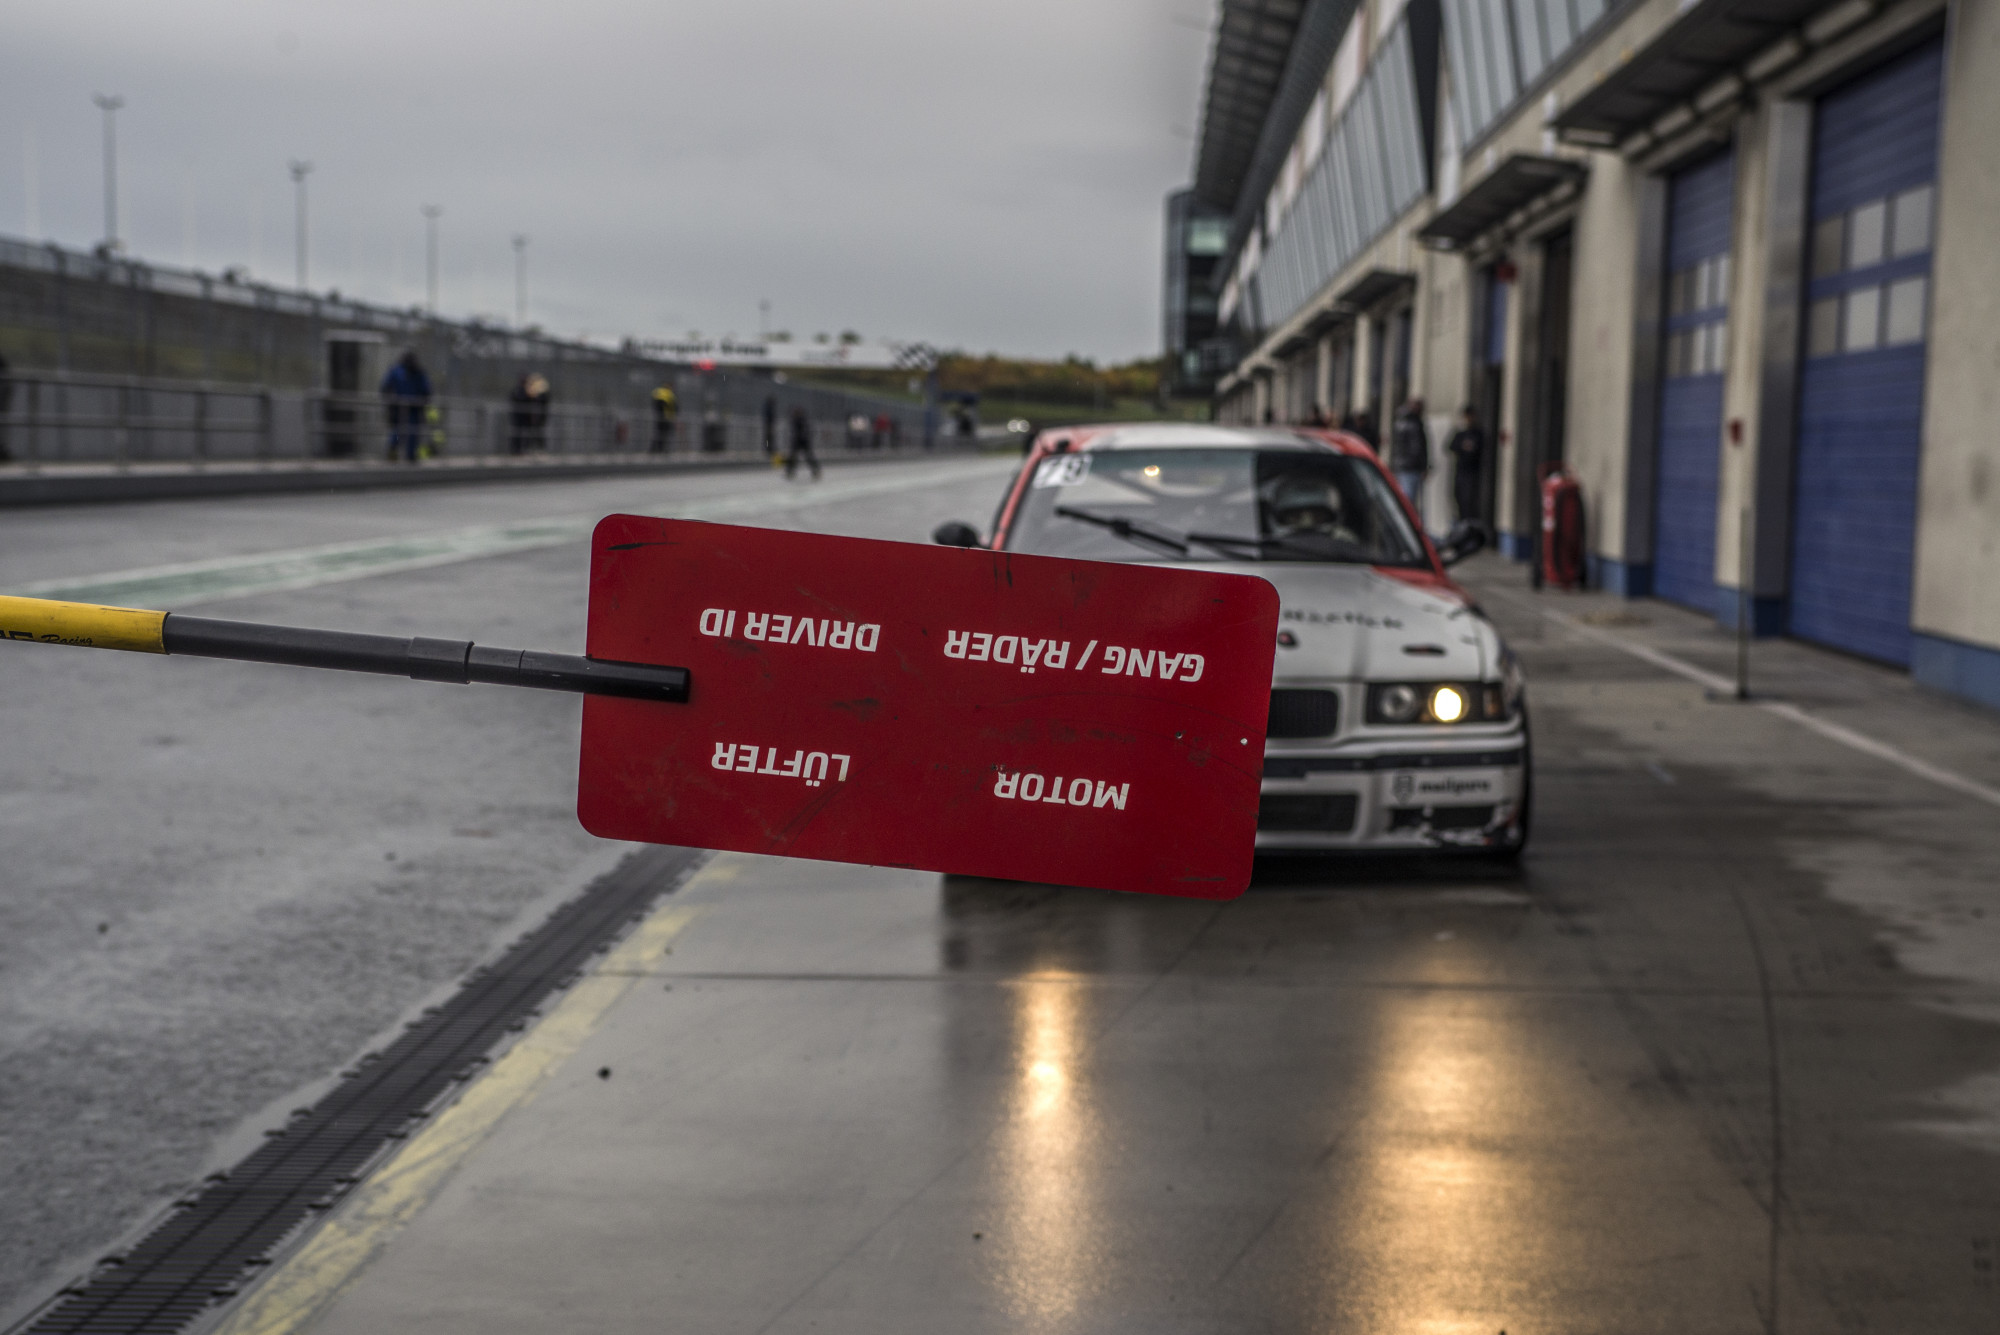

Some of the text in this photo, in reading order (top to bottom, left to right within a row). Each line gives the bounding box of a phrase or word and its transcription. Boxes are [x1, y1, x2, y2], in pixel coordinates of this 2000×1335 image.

[700, 608, 881, 652] DRIVER ID
[944, 629, 1204, 684] GANG / RÄDER
[711, 742, 850, 787] LÜFTER
[993, 769, 1130, 810] MOTOR
